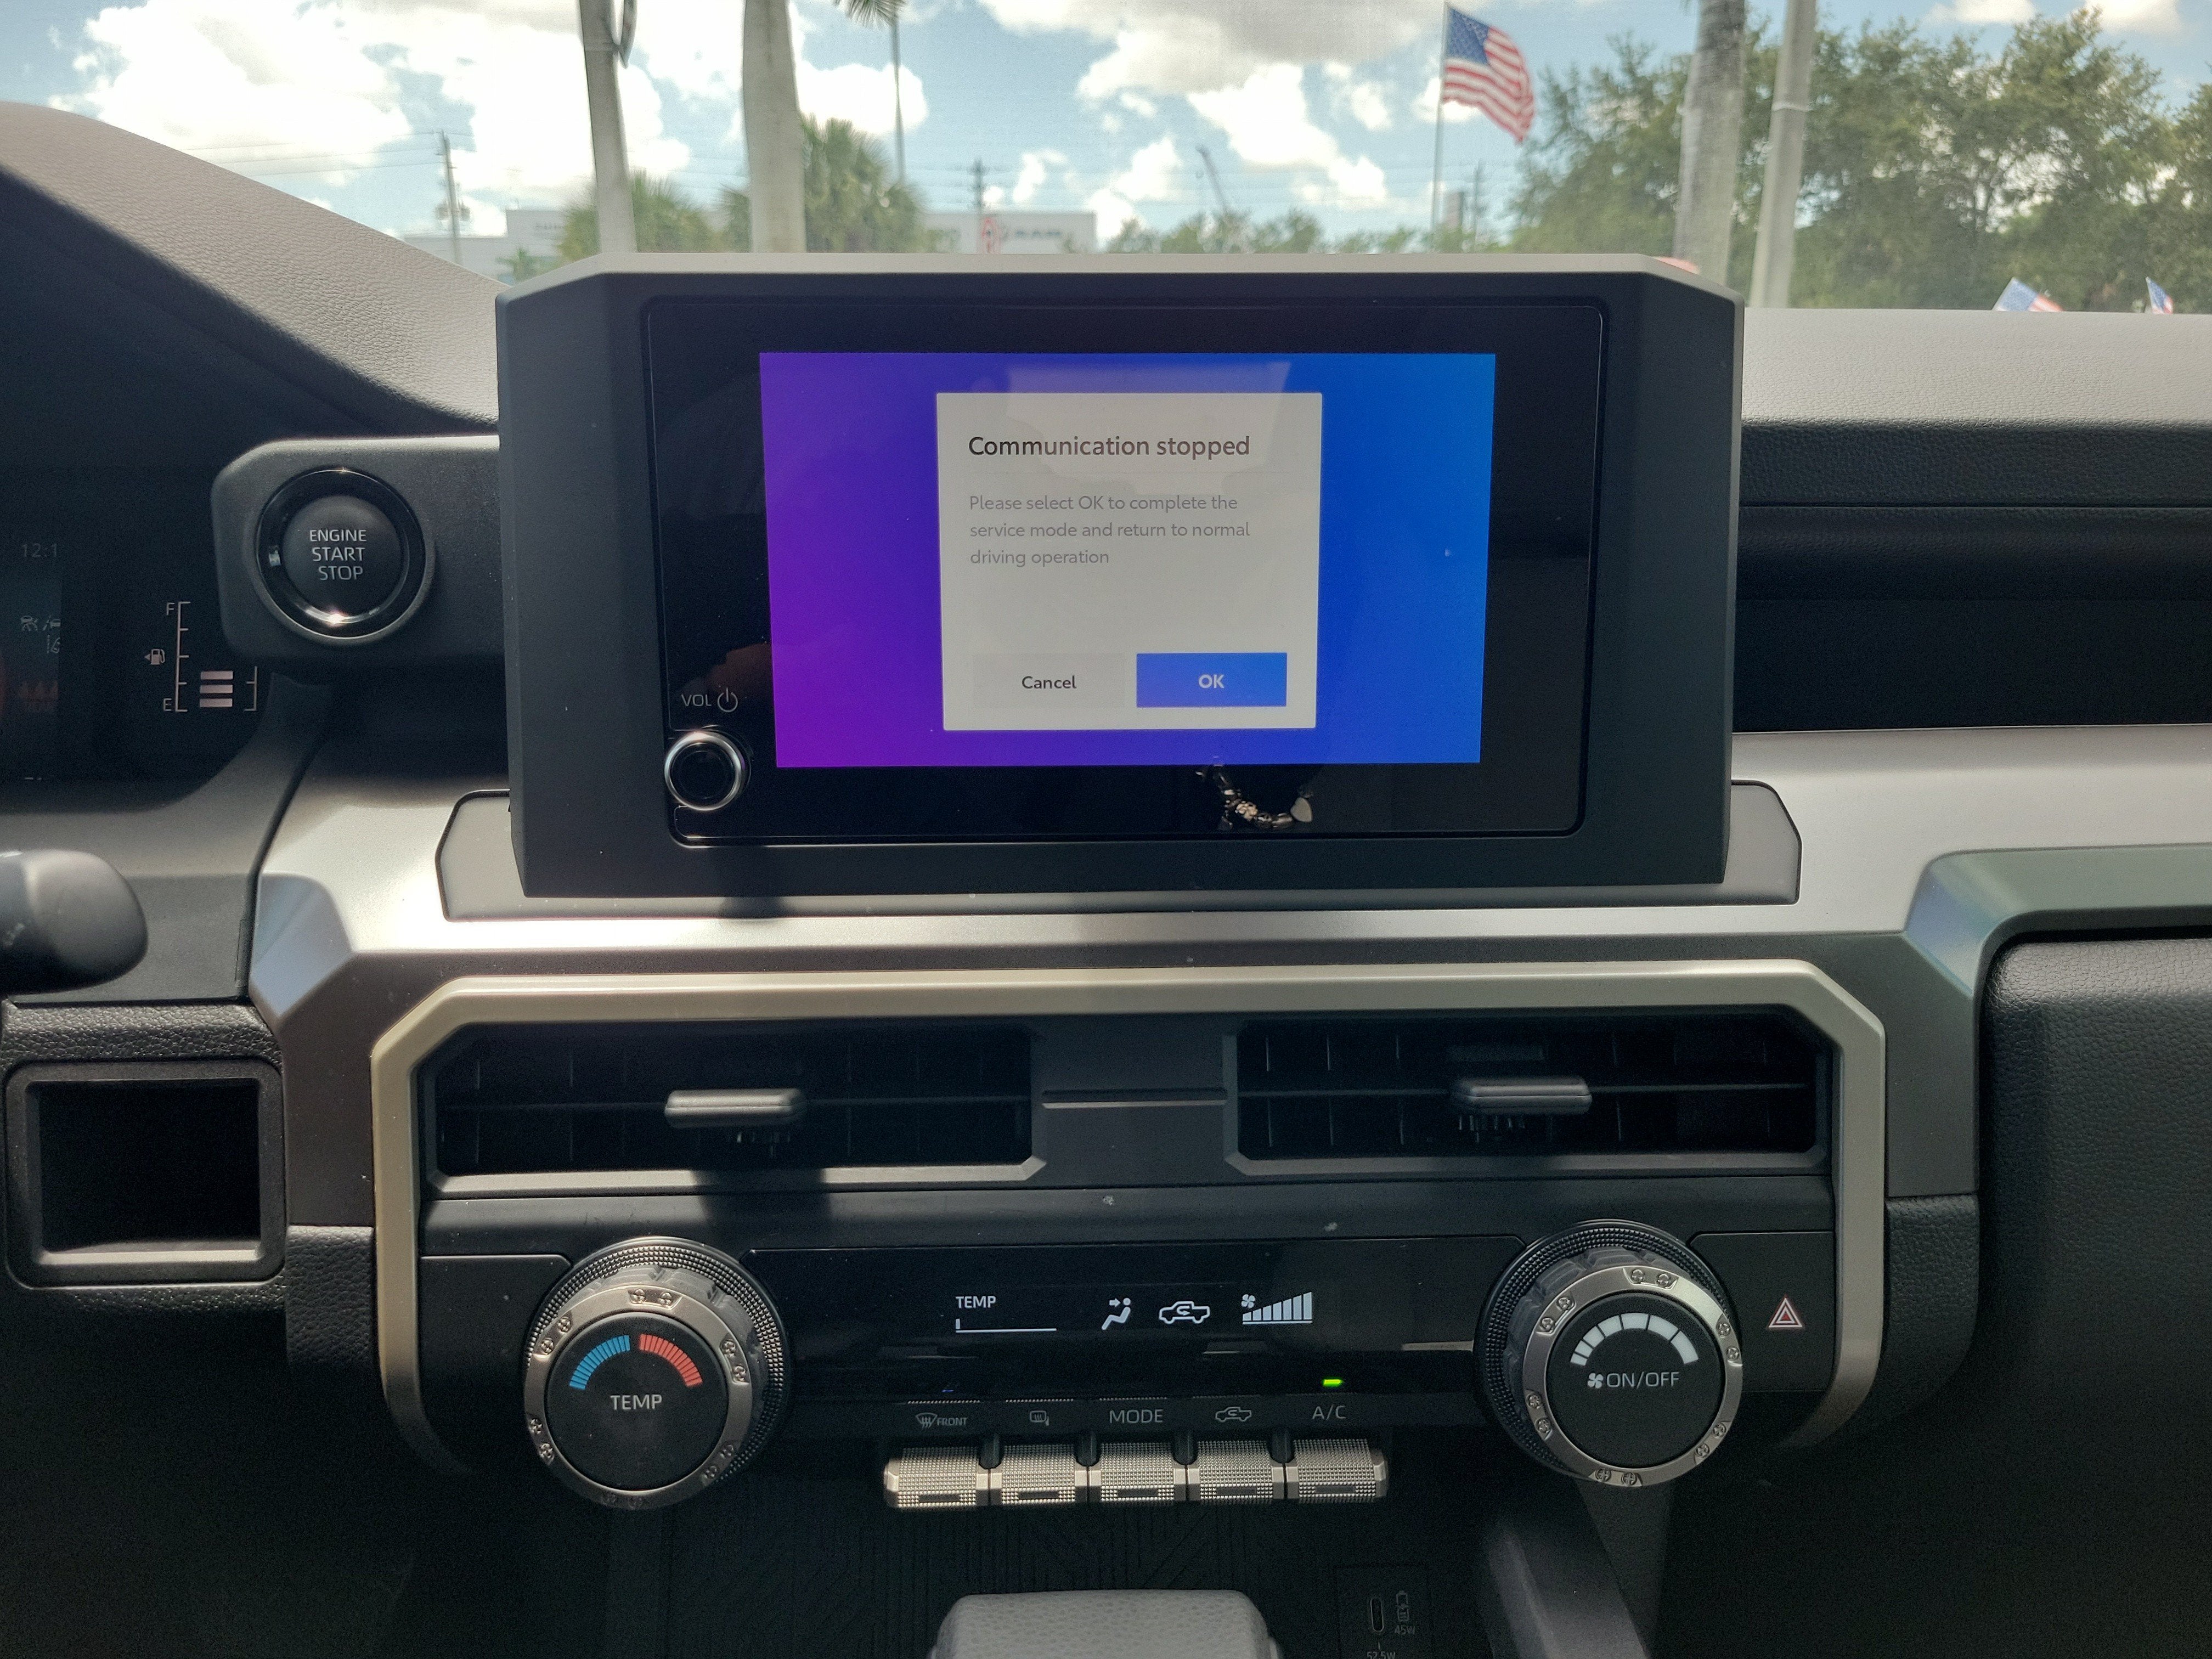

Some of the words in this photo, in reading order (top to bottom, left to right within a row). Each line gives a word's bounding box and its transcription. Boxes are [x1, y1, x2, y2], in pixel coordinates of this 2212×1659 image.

[968, 436, 1149, 456] Communication
[1156, 436, 1250, 460] stopped
[969, 495, 1022, 510] Please
[1026, 495, 1074, 510] select
[1079, 495, 1104, 510] OK
[1108, 497, 1125, 510] to
[1130, 495, 1207, 514] complete
[1211, 495, 1238, 509] the
[309, 529, 367, 541] ENGINE
[970, 523, 1025, 537] service
[1030, 522, 1077, 537] mode
[1082, 522, 1113, 537] and
[1118, 524, 1166, 537] return
[1171, 523, 1188, 537] to
[1192, 521, 1250, 537] normal
[311, 546, 366, 562] START
[970, 550, 1026, 568] driving
[1031, 550, 1109, 568] operation
[318, 566, 363, 580] STOP
[166, 602, 175, 616] F
[1022, 675, 1077, 689] Cancel
[1198, 674, 1224, 689] OK
[163, 698, 172, 712] E
[680, 693, 712, 706] VOL
[956, 1295, 996, 1309] TEMP
[1606, 1371, 1679, 1390] ON/OFF
[610, 1393, 663, 1410] TEMP
[1109, 1408, 1164, 1424] MODE
[1312, 1404, 1346, 1421] A/C
[936, 1415, 968, 1426] FRONT
[1394, 1624, 1416, 1635] 45W
